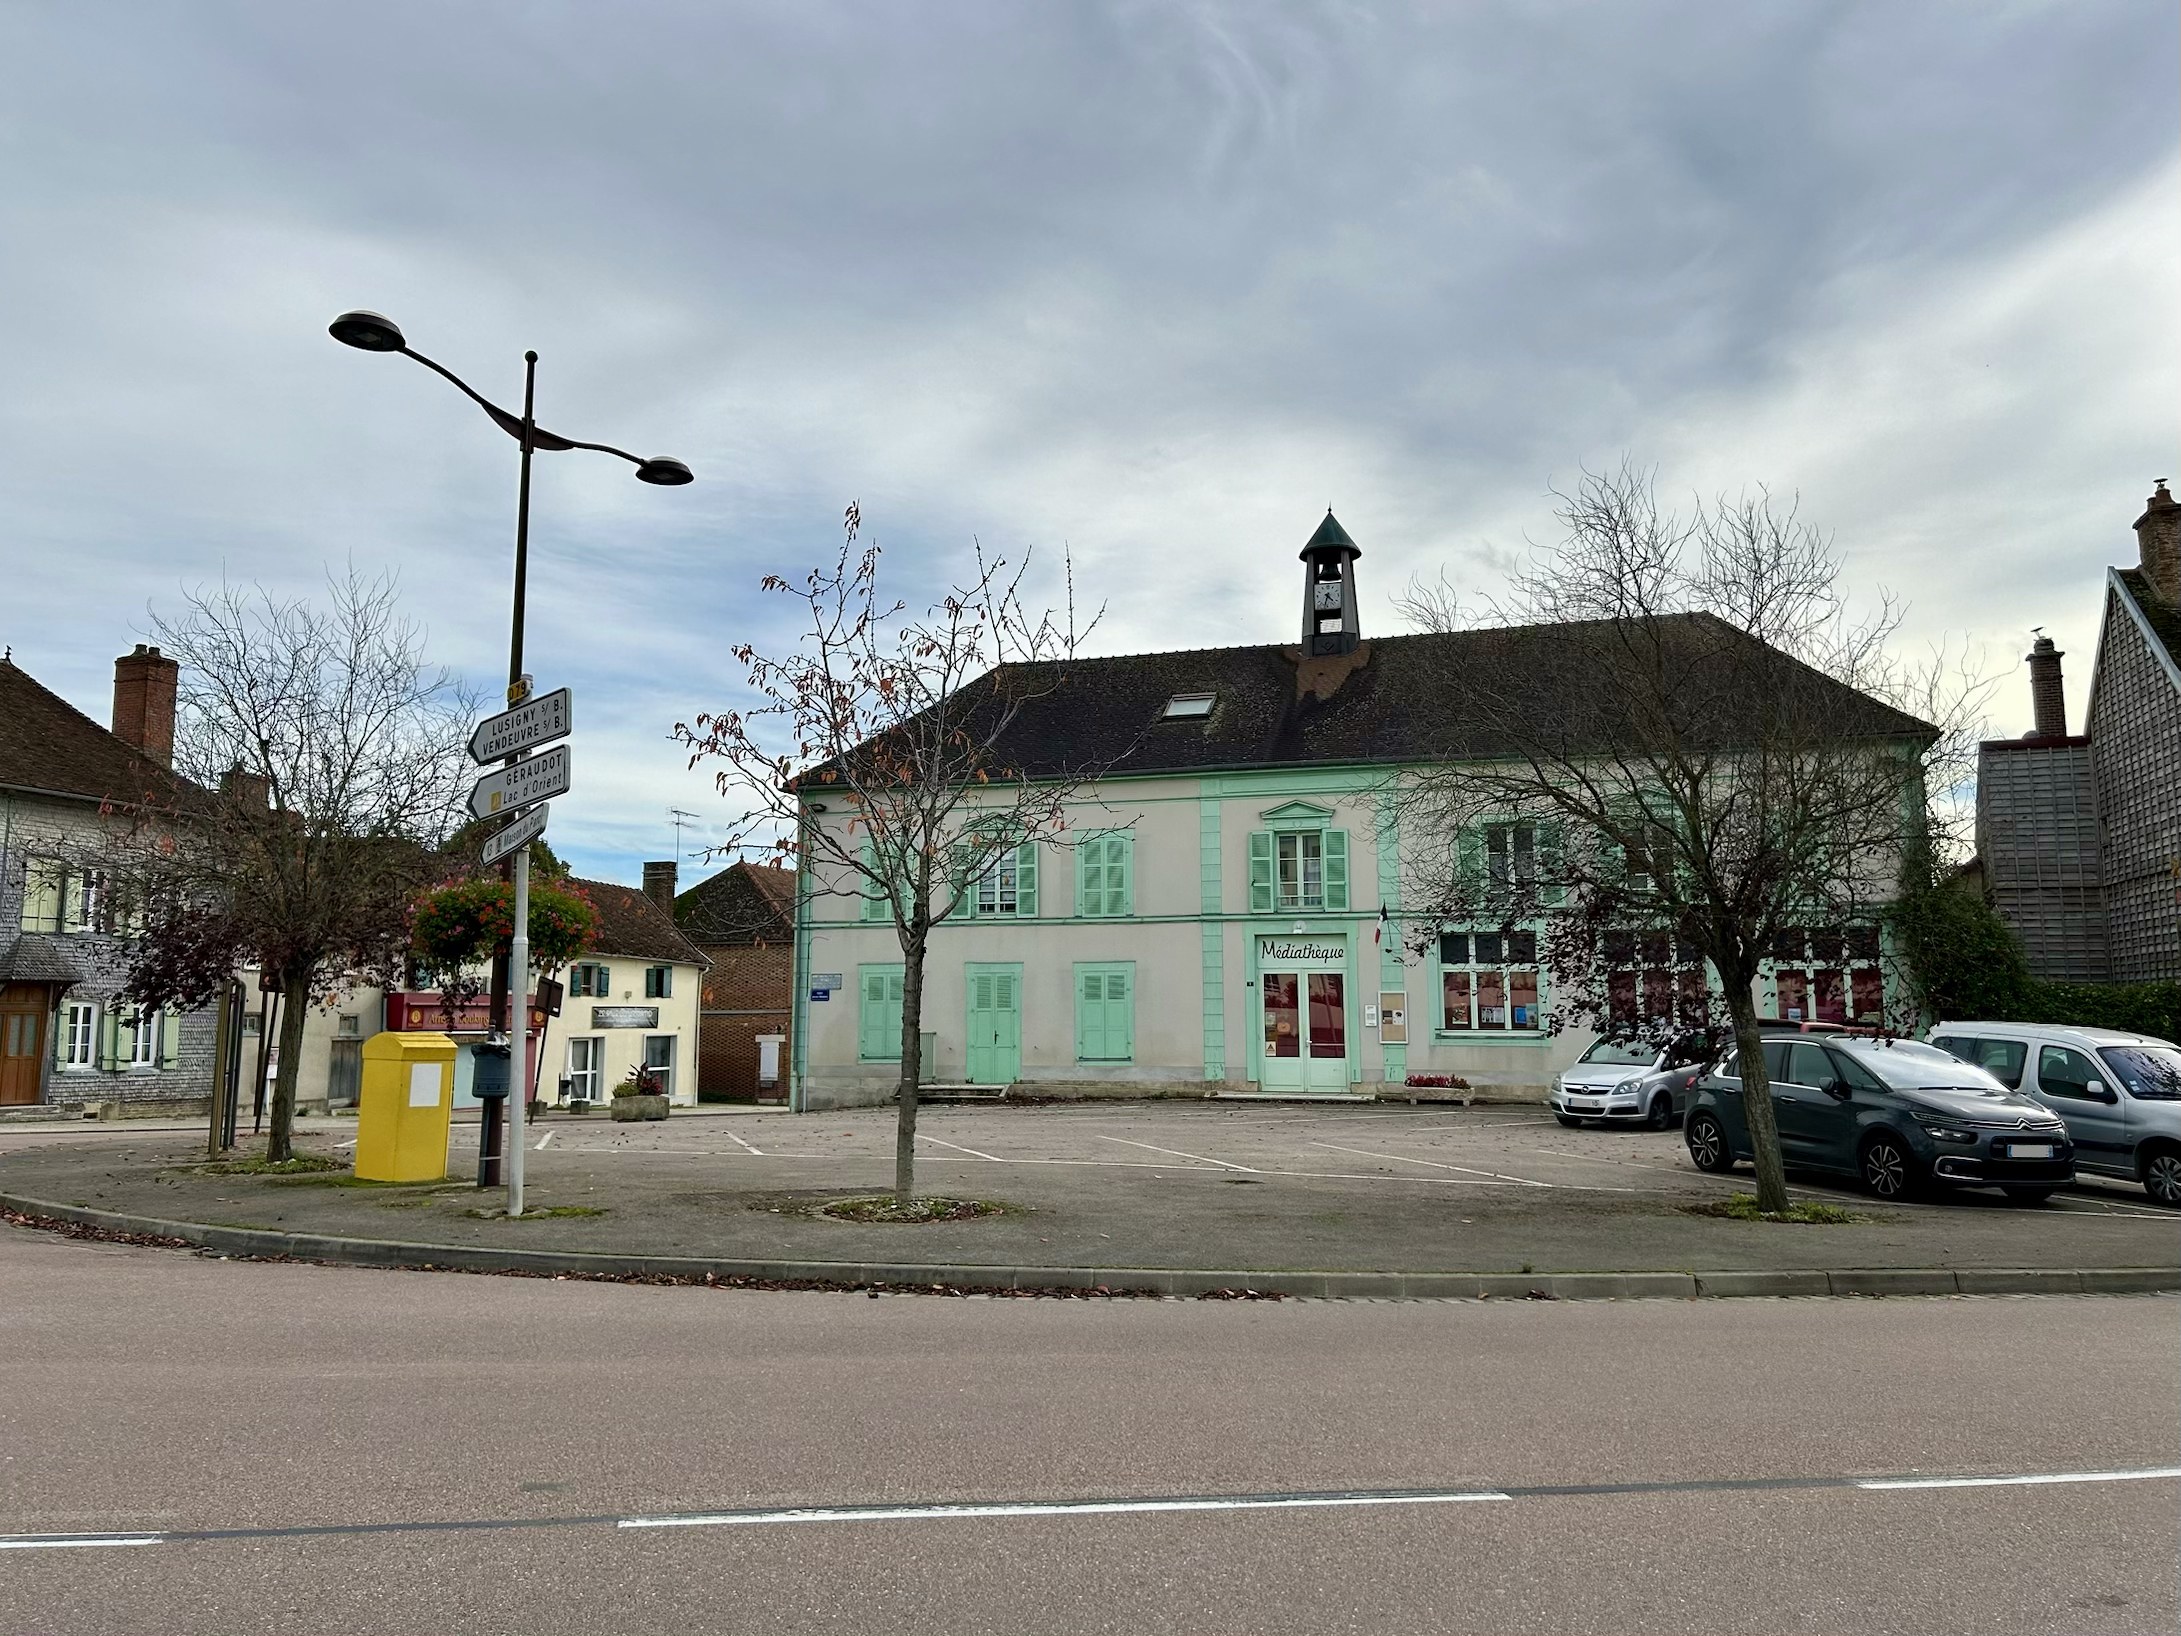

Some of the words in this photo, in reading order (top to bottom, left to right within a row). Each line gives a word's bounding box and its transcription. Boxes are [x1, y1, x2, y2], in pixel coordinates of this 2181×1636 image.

[516, 683, 526, 697] 79
[492, 707, 536, 736] LUSIGNY
[483, 723, 540, 755] VENDEUVRE
[506, 753, 562, 786] GÉRAUDOT
[503, 791, 518, 804] Lac
[523, 773, 562, 797] d'Orient
[1262, 940, 1344, 964] Médiathèque
